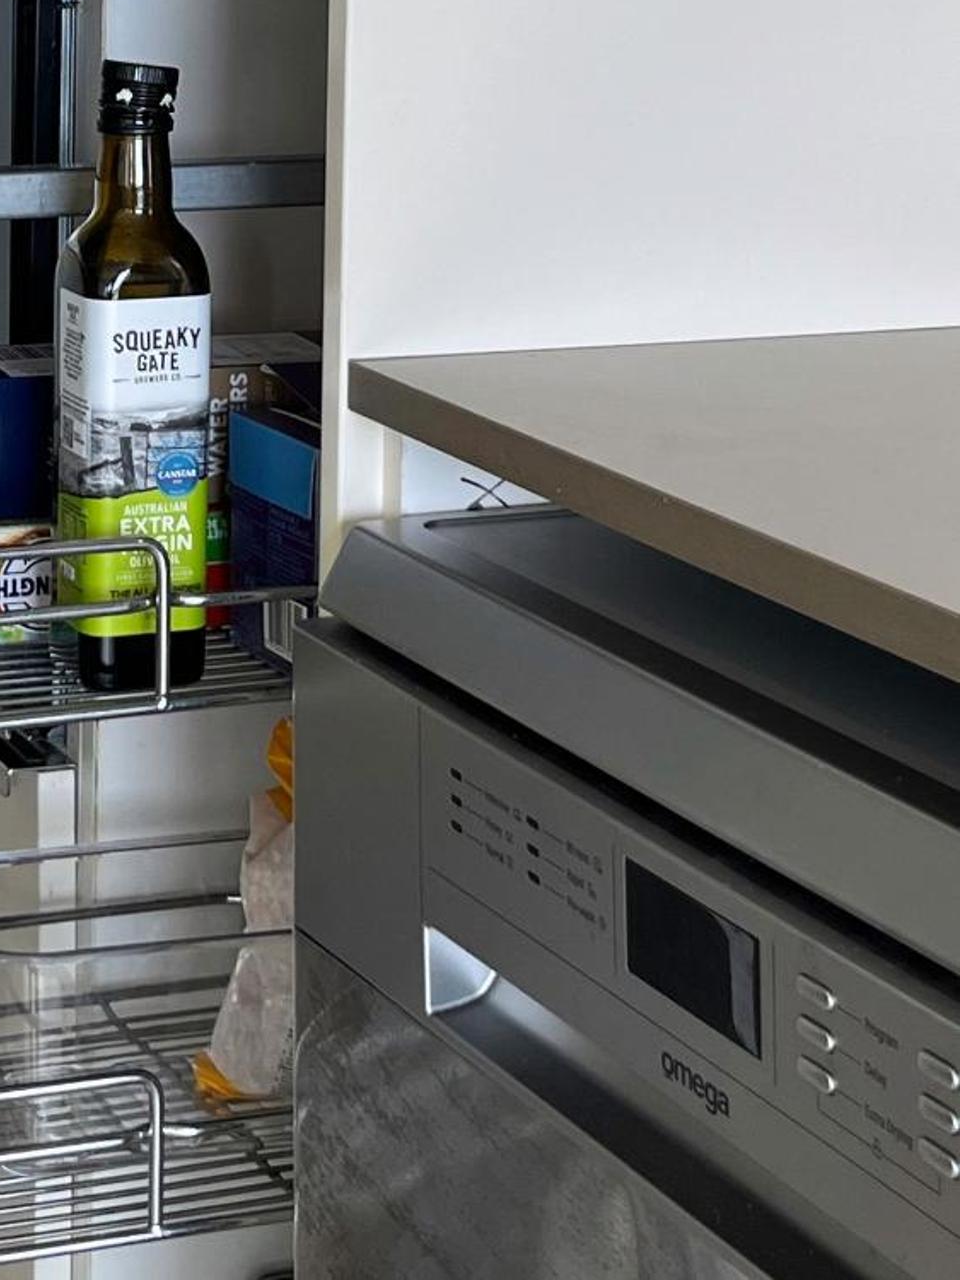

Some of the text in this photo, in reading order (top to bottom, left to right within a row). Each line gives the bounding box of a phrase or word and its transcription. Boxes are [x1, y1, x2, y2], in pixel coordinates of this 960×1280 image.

[112, 326, 202, 354] SQUEAKY
[136, 351, 180, 373] GATE
[208, 397, 228, 477] WATER
[157, 468, 197, 479] CANSTAR
[124, 501, 188, 517] AUSTRALIAN
[120, 514, 192, 537] EXTRA
[129, 554, 154, 568] OLIV
[661, 1051, 731, 1119] omega
